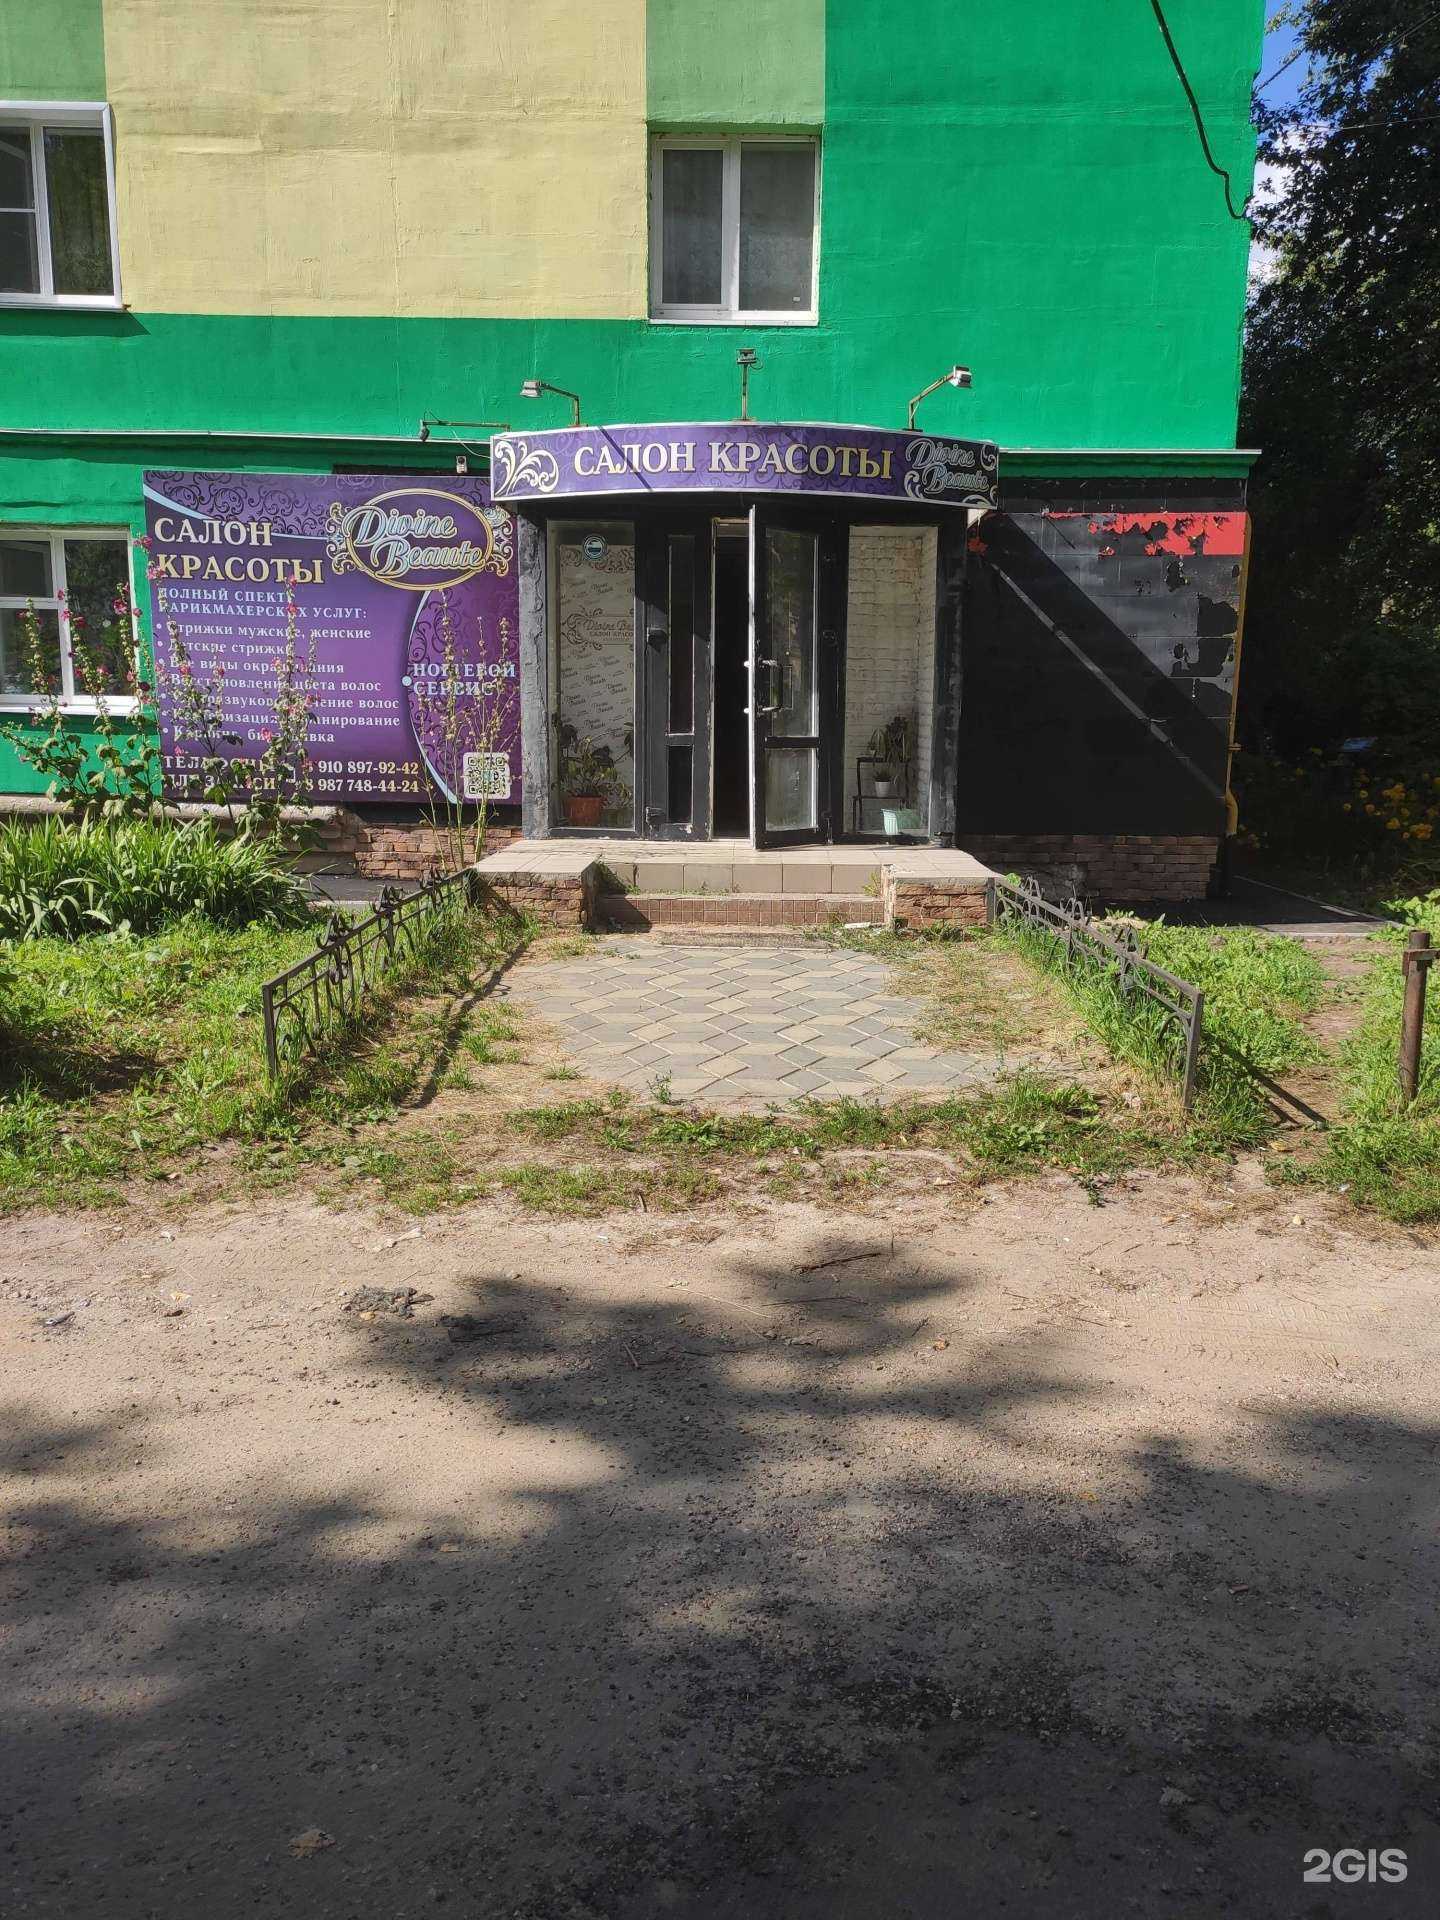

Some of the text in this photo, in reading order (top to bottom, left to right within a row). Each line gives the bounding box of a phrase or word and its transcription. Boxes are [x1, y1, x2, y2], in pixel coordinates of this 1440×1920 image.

[574, 441, 894, 479] САЛОН КРАСОТЫ
[905, 438, 976, 470] Divine
[922, 462, 990, 494] Beaute
[154, 518, 273, 547] САЛОН
[342, 505, 458, 548] Divine
[369, 538, 486, 580] Beaute
[157, 553, 325, 584] КРАСОТЫ
[158, 587, 294, 603] ПОЛНЫЙ СПЕКТ
[159, 601, 367, 619] АРИКМАХЕРСКХ УСЛУГ:
[311, 628, 372, 639] женские
[168, 639, 226, 653] Дтские
[170, 655, 194, 668] Ве
[243, 662, 344, 674] окравания
[413, 663, 516, 677] НОГЕВОЙ
[341, 682, 382, 691] волос
[295, 698, 354, 708] чение
[359, 700, 399, 709] волос
[318, 761, 343, 773] 910
[347, 761, 419, 774] 897-92-42
[318, 779, 343, 791] 987
[347, 779, 419, 792] 748-44-24
